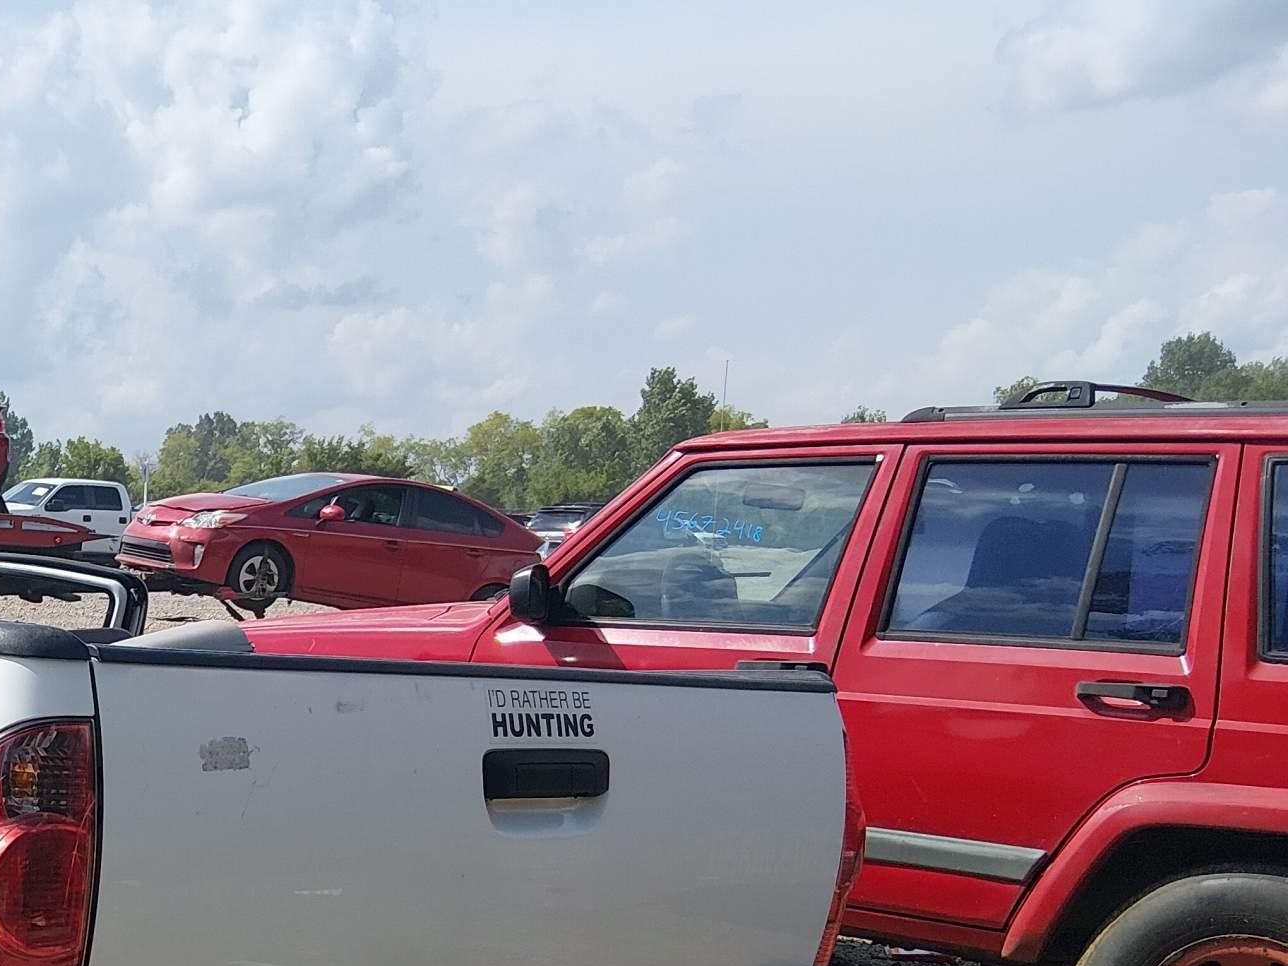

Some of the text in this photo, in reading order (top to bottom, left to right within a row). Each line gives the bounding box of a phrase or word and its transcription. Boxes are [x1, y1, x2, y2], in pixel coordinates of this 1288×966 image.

[488, 689, 592, 709] I'D RATHER BE
[491, 712, 595, 738] HUNTING
